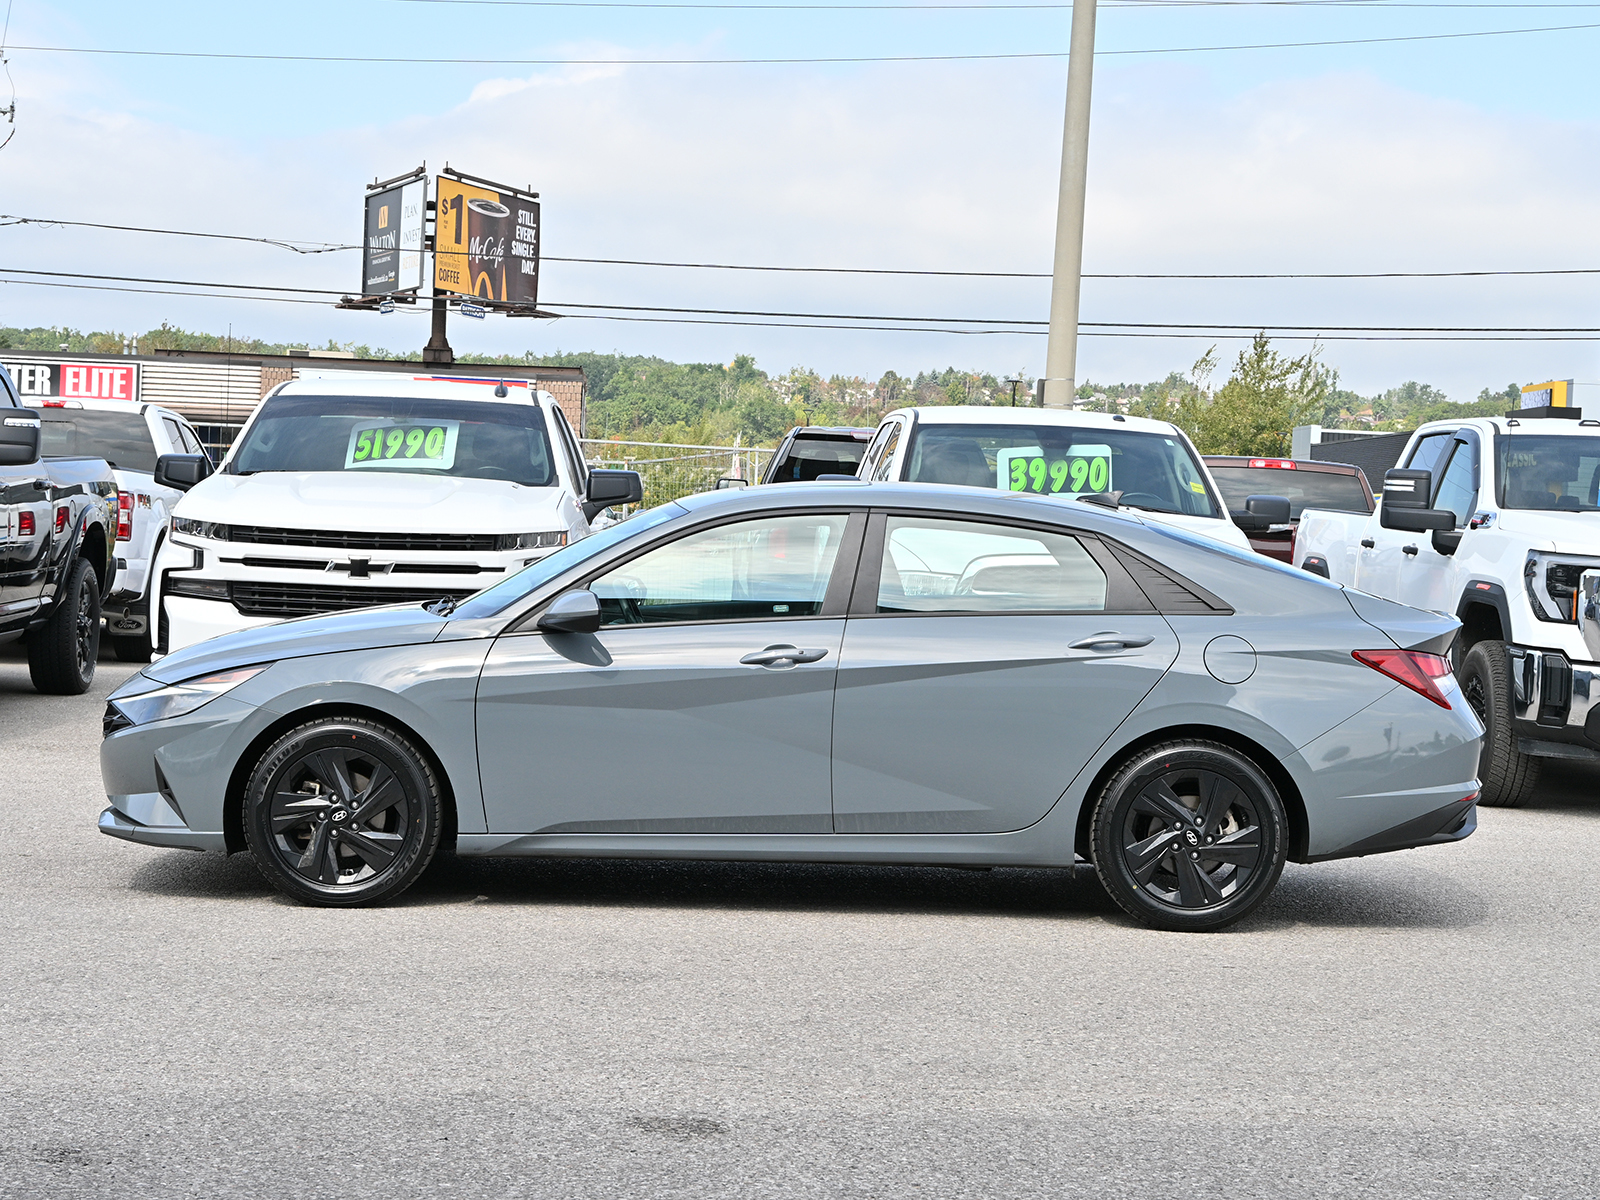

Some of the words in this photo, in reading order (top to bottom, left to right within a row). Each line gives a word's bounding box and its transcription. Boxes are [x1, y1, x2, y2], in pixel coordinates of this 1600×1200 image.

[517, 209, 537, 227] STILL.
[515, 225, 537, 243] EVERY.
[511, 240, 536, 258] SINGLE.
[438, 267, 461, 285] COFFEE
[520, 259, 536, 275] DAY.
[3, 364, 51, 395] TER
[65, 366, 127, 398] ELITE
[354, 427, 445, 461] 51990
[1010, 456, 1108, 493] 39990
[117, 619, 138, 629] Ford
[261, 741, 300, 786] SAILUN
[384, 824, 424, 886] ATREZZO
